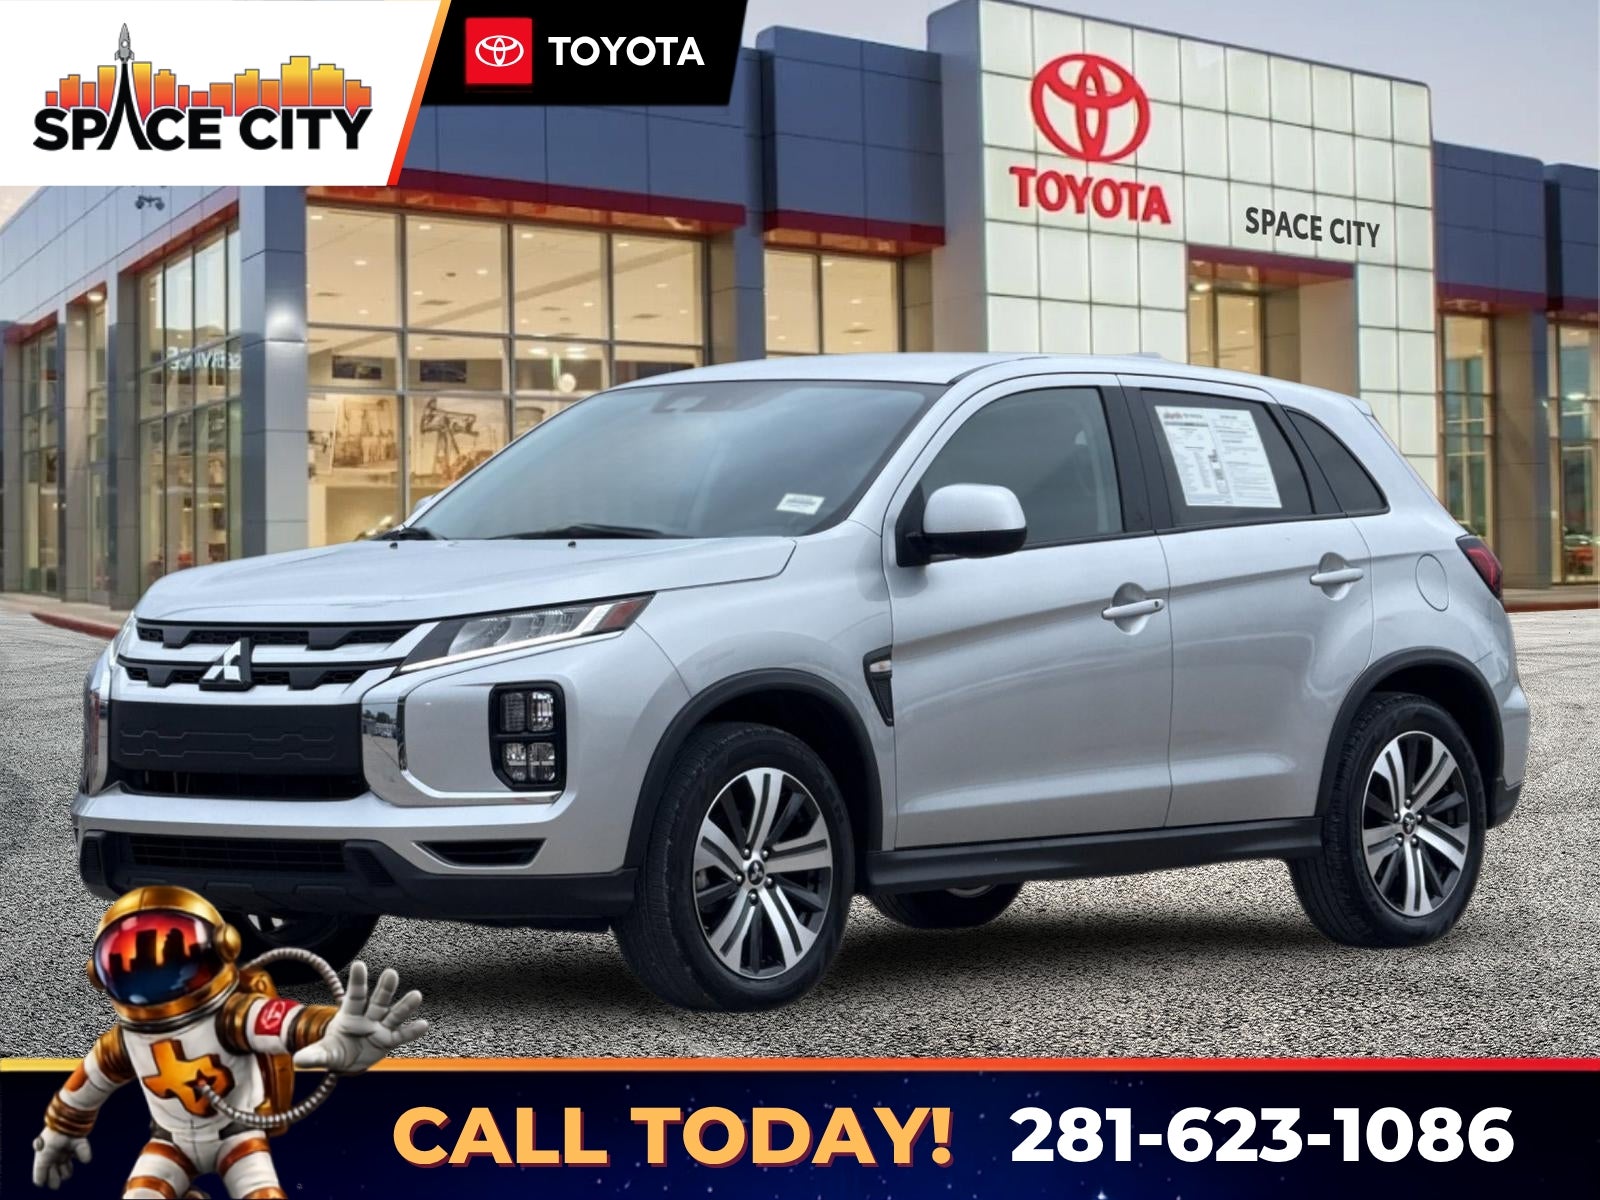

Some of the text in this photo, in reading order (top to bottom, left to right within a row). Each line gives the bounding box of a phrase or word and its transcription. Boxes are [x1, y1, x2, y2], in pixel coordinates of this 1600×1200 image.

[1009, 166, 1171, 225] TOYOTA
[1245, 207, 1381, 248] SPACE CITY
